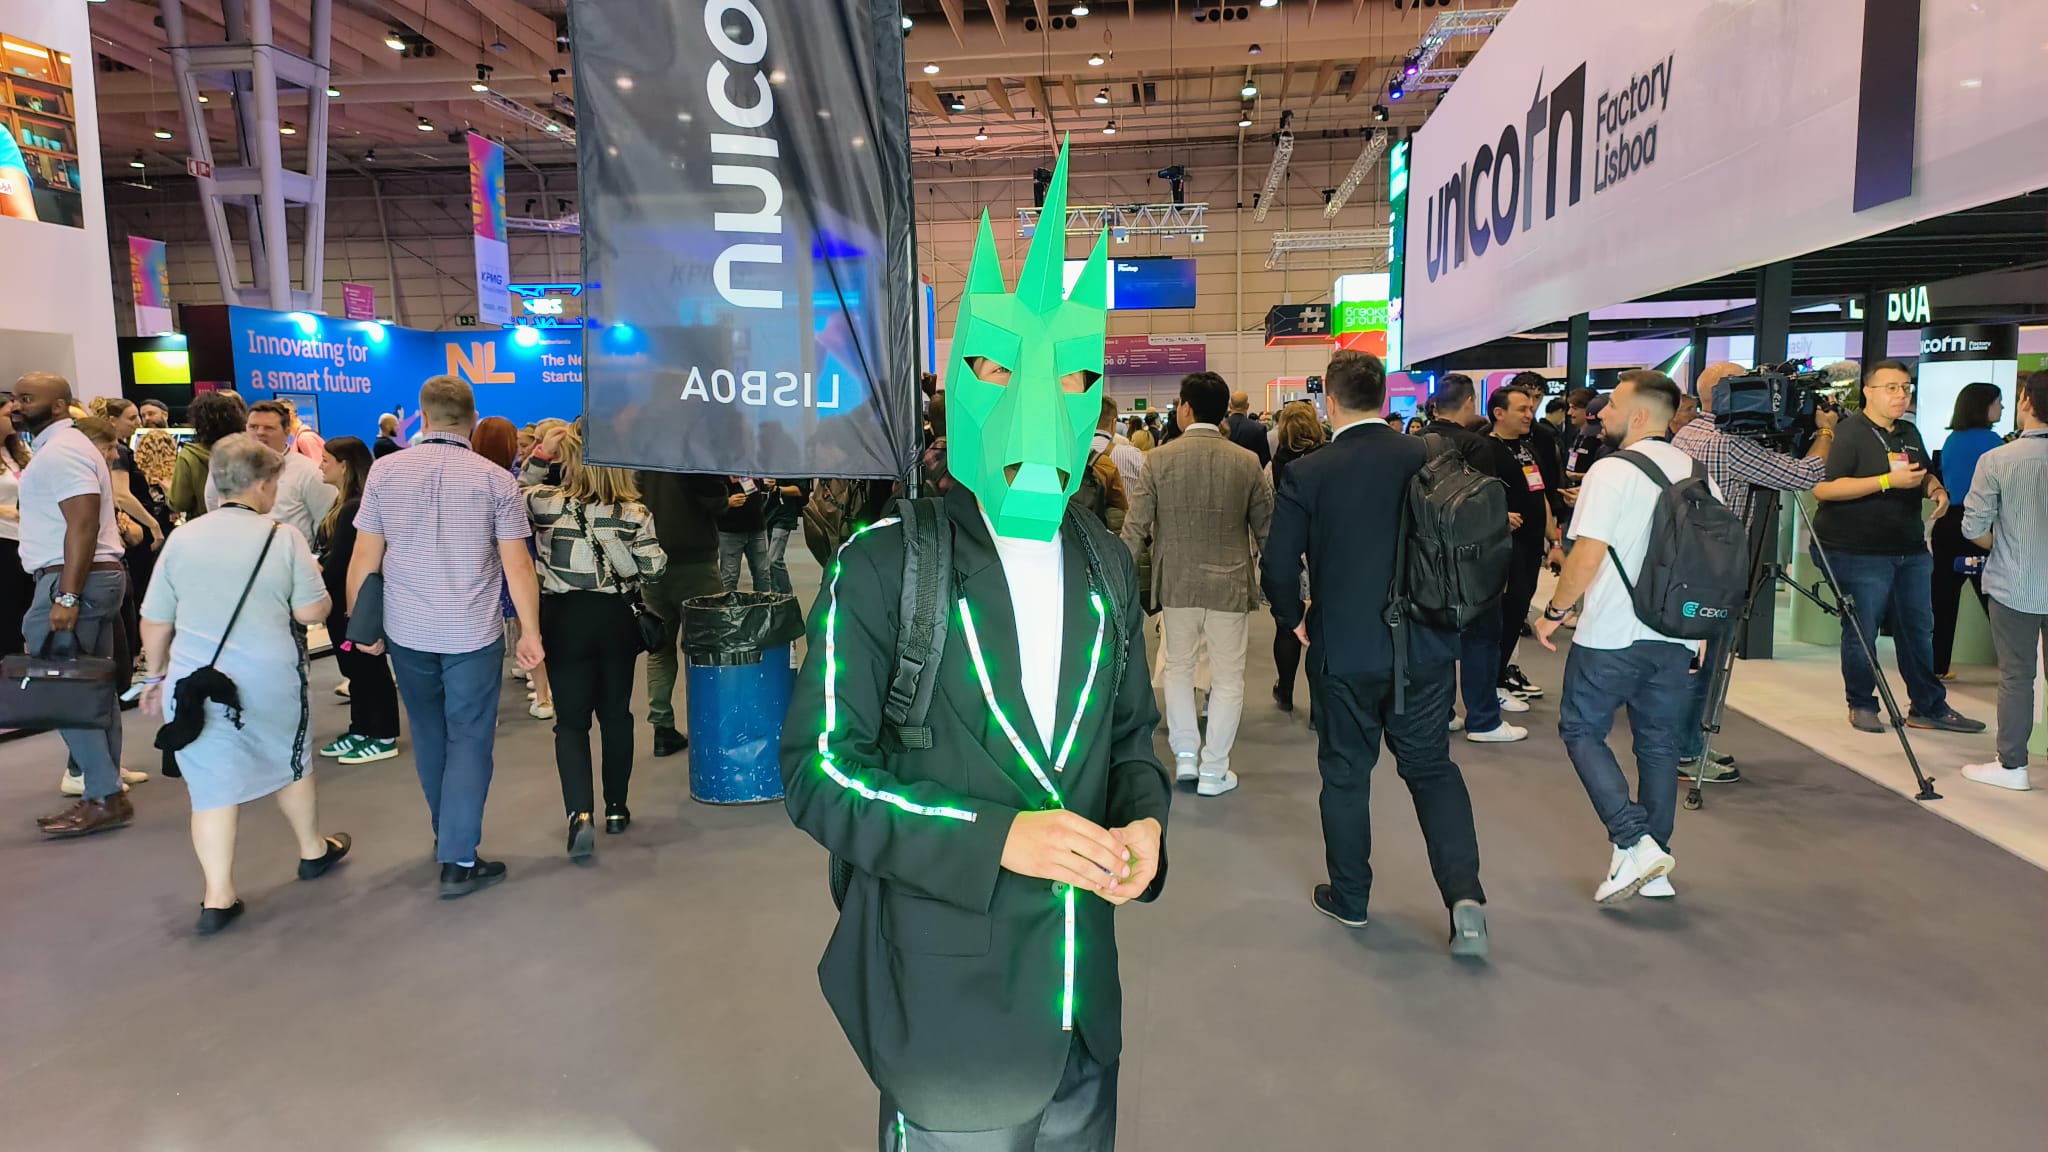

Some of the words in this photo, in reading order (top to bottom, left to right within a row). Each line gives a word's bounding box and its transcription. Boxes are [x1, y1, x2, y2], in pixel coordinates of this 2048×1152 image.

[1596, 54, 1674, 143] Factory
[1426, 61, 1587, 283] unicorn
[1593, 122, 1658, 194] Lisboa
[481, 271, 503, 286] KPMG
[247, 330, 345, 367] Innovating
[346, 337, 369, 362] for
[445, 341, 515, 384] NL
[541, 353, 565, 367] The
[251, 370, 265, 389] a
[267, 369, 322, 391] smart
[323, 367, 372, 394] future
